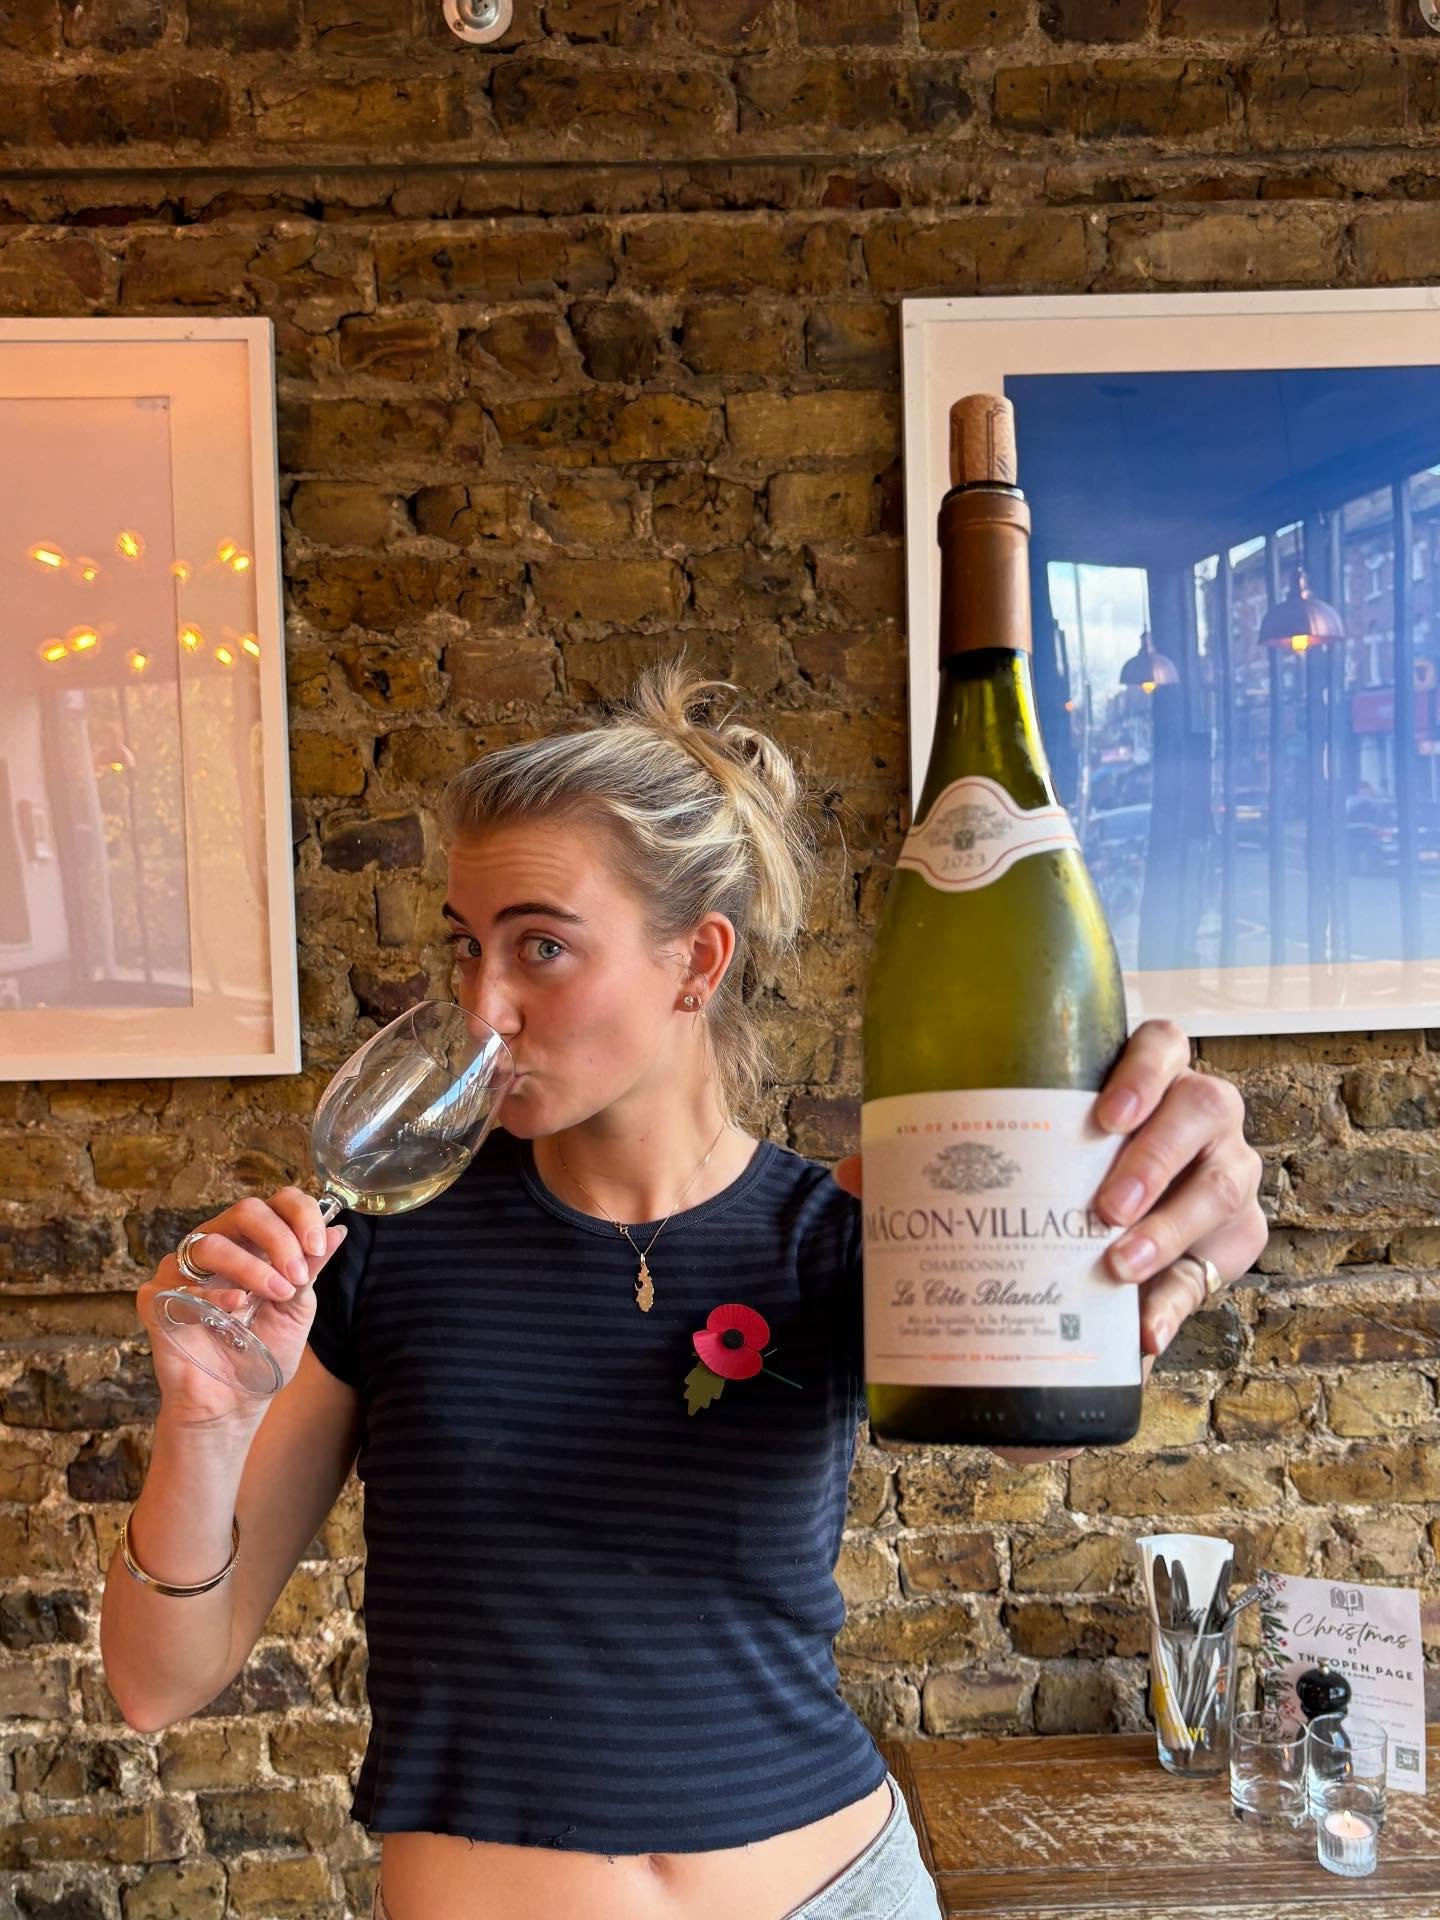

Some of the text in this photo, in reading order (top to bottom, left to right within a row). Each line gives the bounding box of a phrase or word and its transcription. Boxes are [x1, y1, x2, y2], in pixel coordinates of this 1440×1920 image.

[866, 1204, 1106, 1242] MÂCON-VILLAGE
[919, 1257, 1027, 1273] CHARDONNAY
[971, 1278, 1063, 1307] Blanche
[1292, 1613, 1413, 1649] Christmas
[1347, 1647, 1357, 1655] AT
[1330, 1657, 1370, 1673] OPEN
[1376, 1666, 1414, 1681] PAGE
